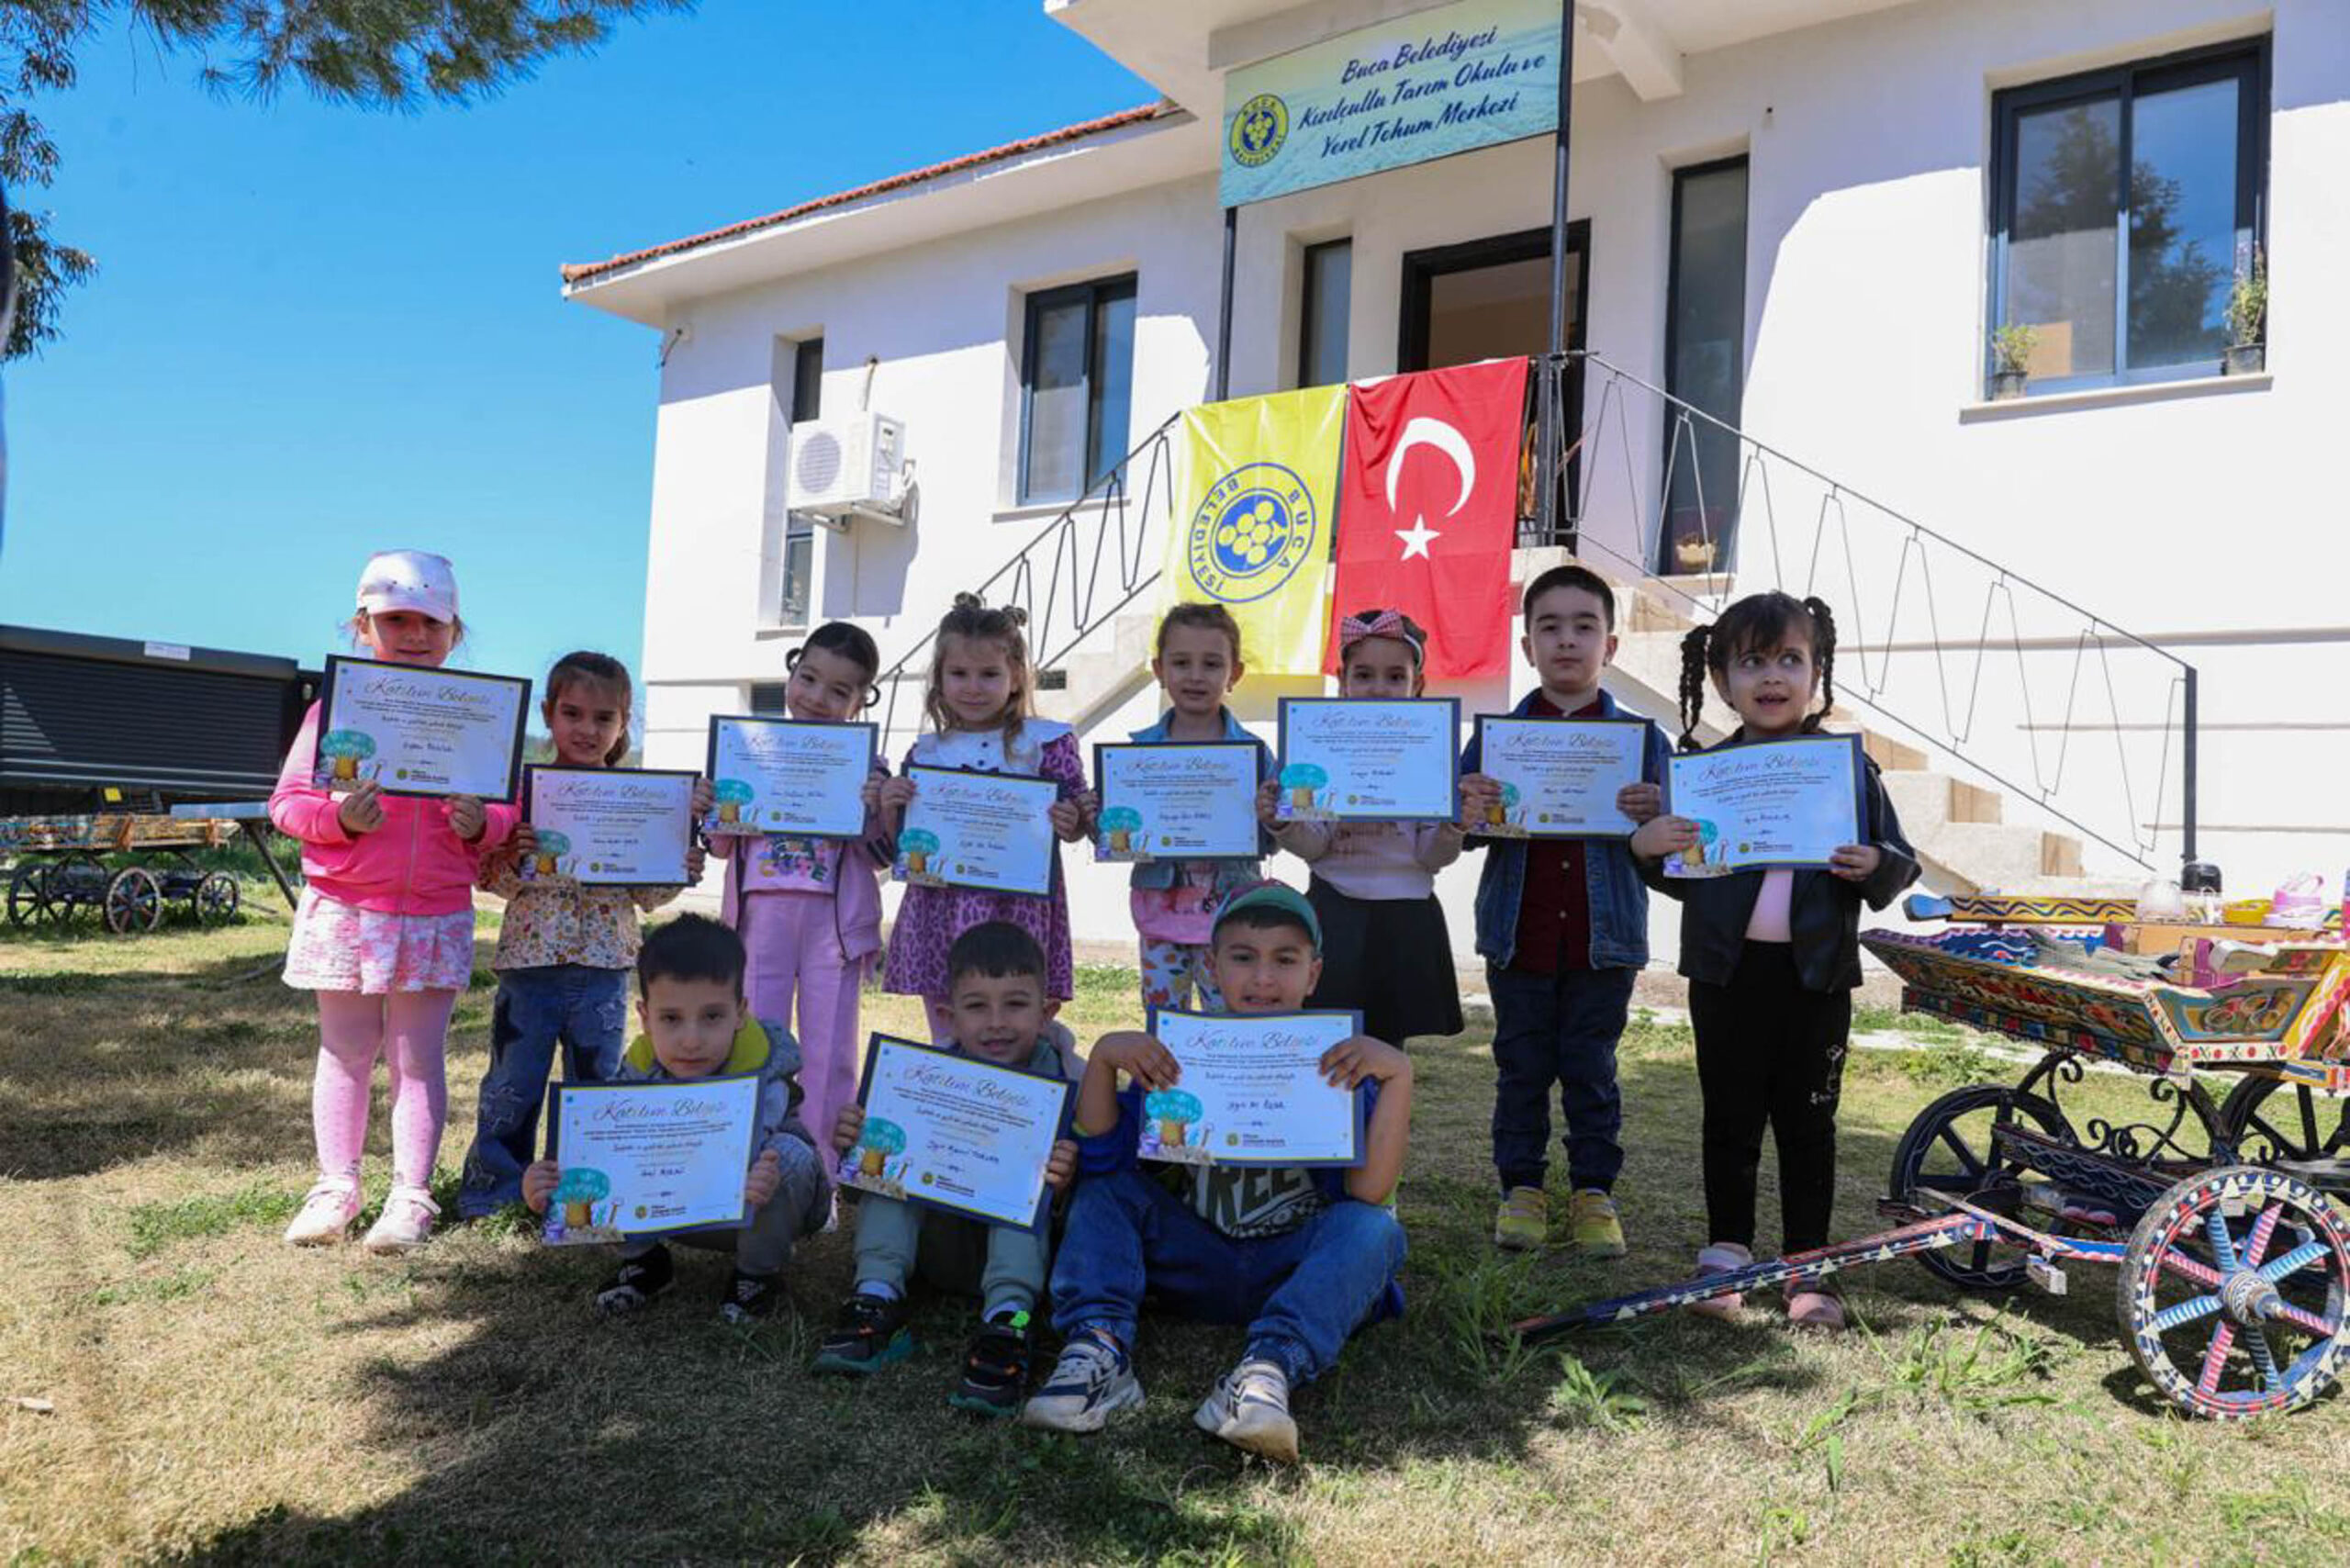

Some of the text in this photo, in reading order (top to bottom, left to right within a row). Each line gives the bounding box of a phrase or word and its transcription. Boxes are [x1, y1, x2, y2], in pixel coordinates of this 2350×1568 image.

[1341, 25, 1498, 84] Buca Belediyesi
[1392, 78, 1448, 106] Tarım
[1454, 52, 1518, 87] Okulu
[1321, 91, 1520, 159] Yerel Tohum Merkezi
[1277, 488, 1309, 569] BUCA
[1184, 1167, 1302, 1228] REE
